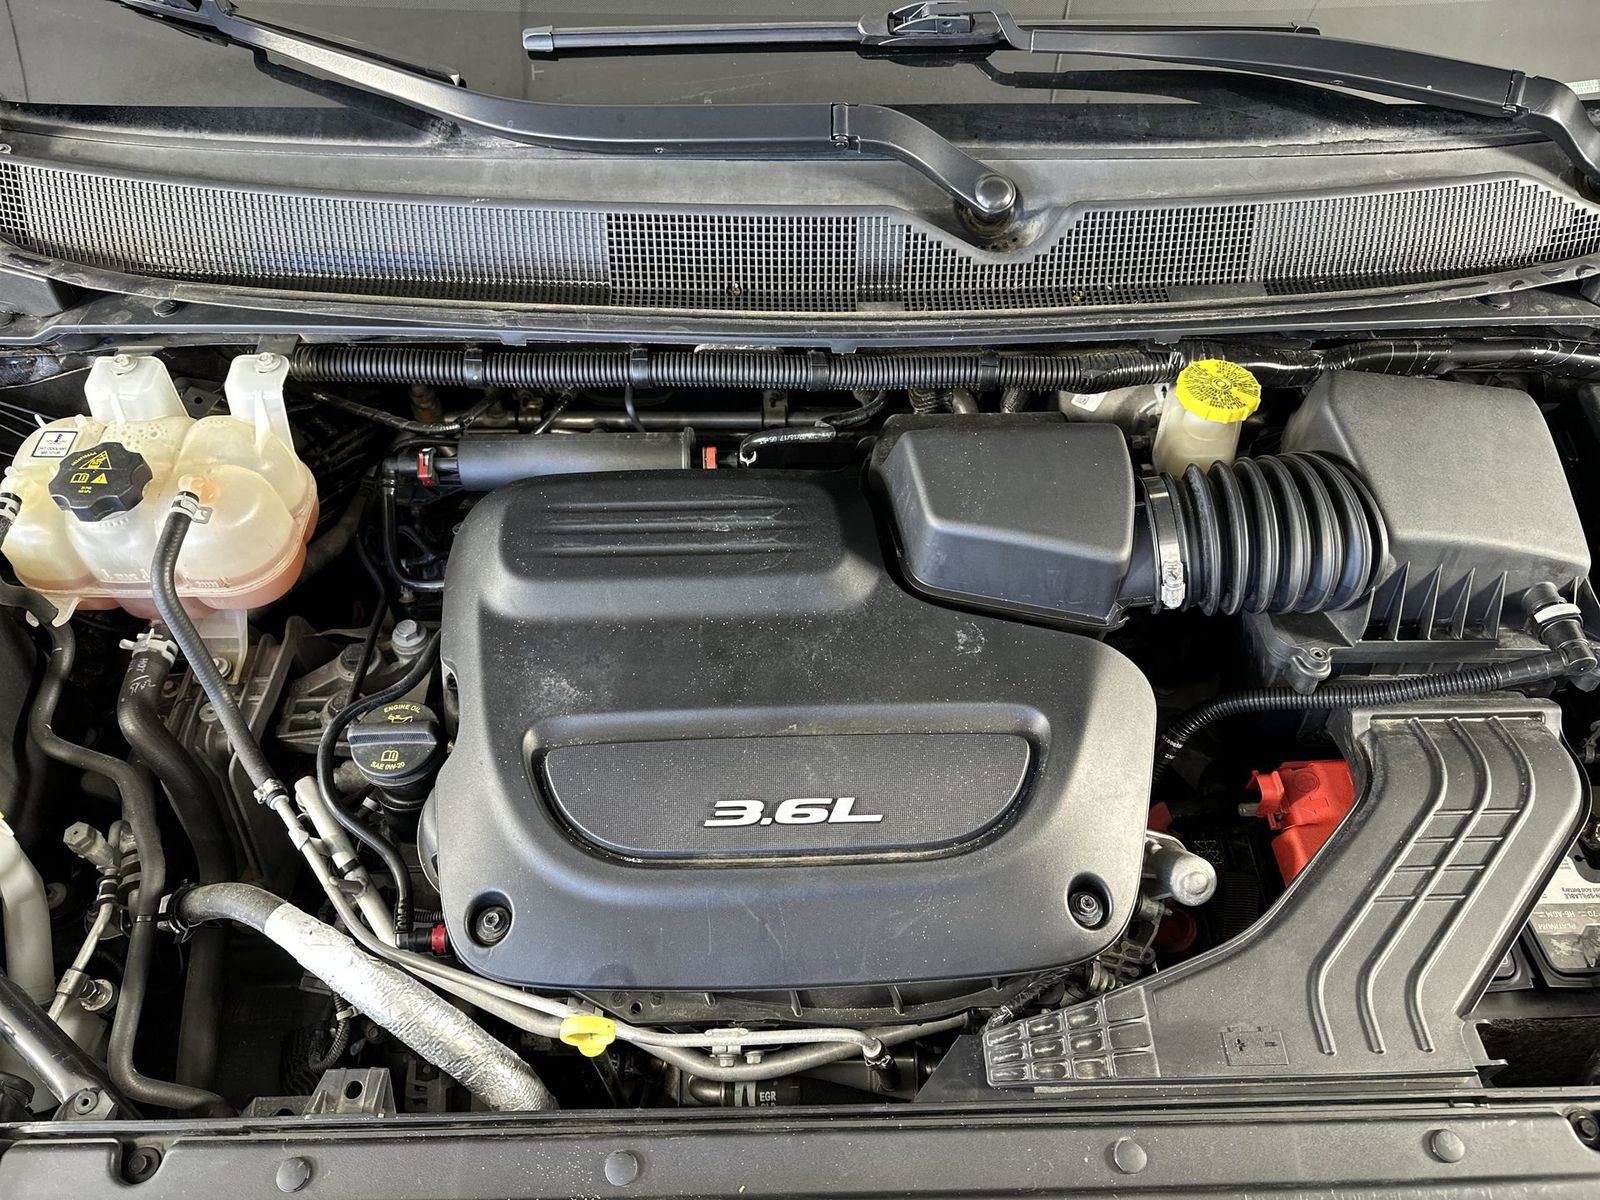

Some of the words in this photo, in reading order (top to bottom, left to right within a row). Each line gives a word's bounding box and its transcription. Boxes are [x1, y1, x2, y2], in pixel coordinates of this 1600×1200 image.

[383, 704, 411, 713] ENGINE
[410, 704, 421, 714] OIL
[370, 760, 384, 770] SAE
[384, 761, 406, 771] 0W-20
[703, 797, 884, 828] 3.6L
[1537, 922, 1577, 930] PLATINUM
[759, 1090, 777, 1102] EGR
